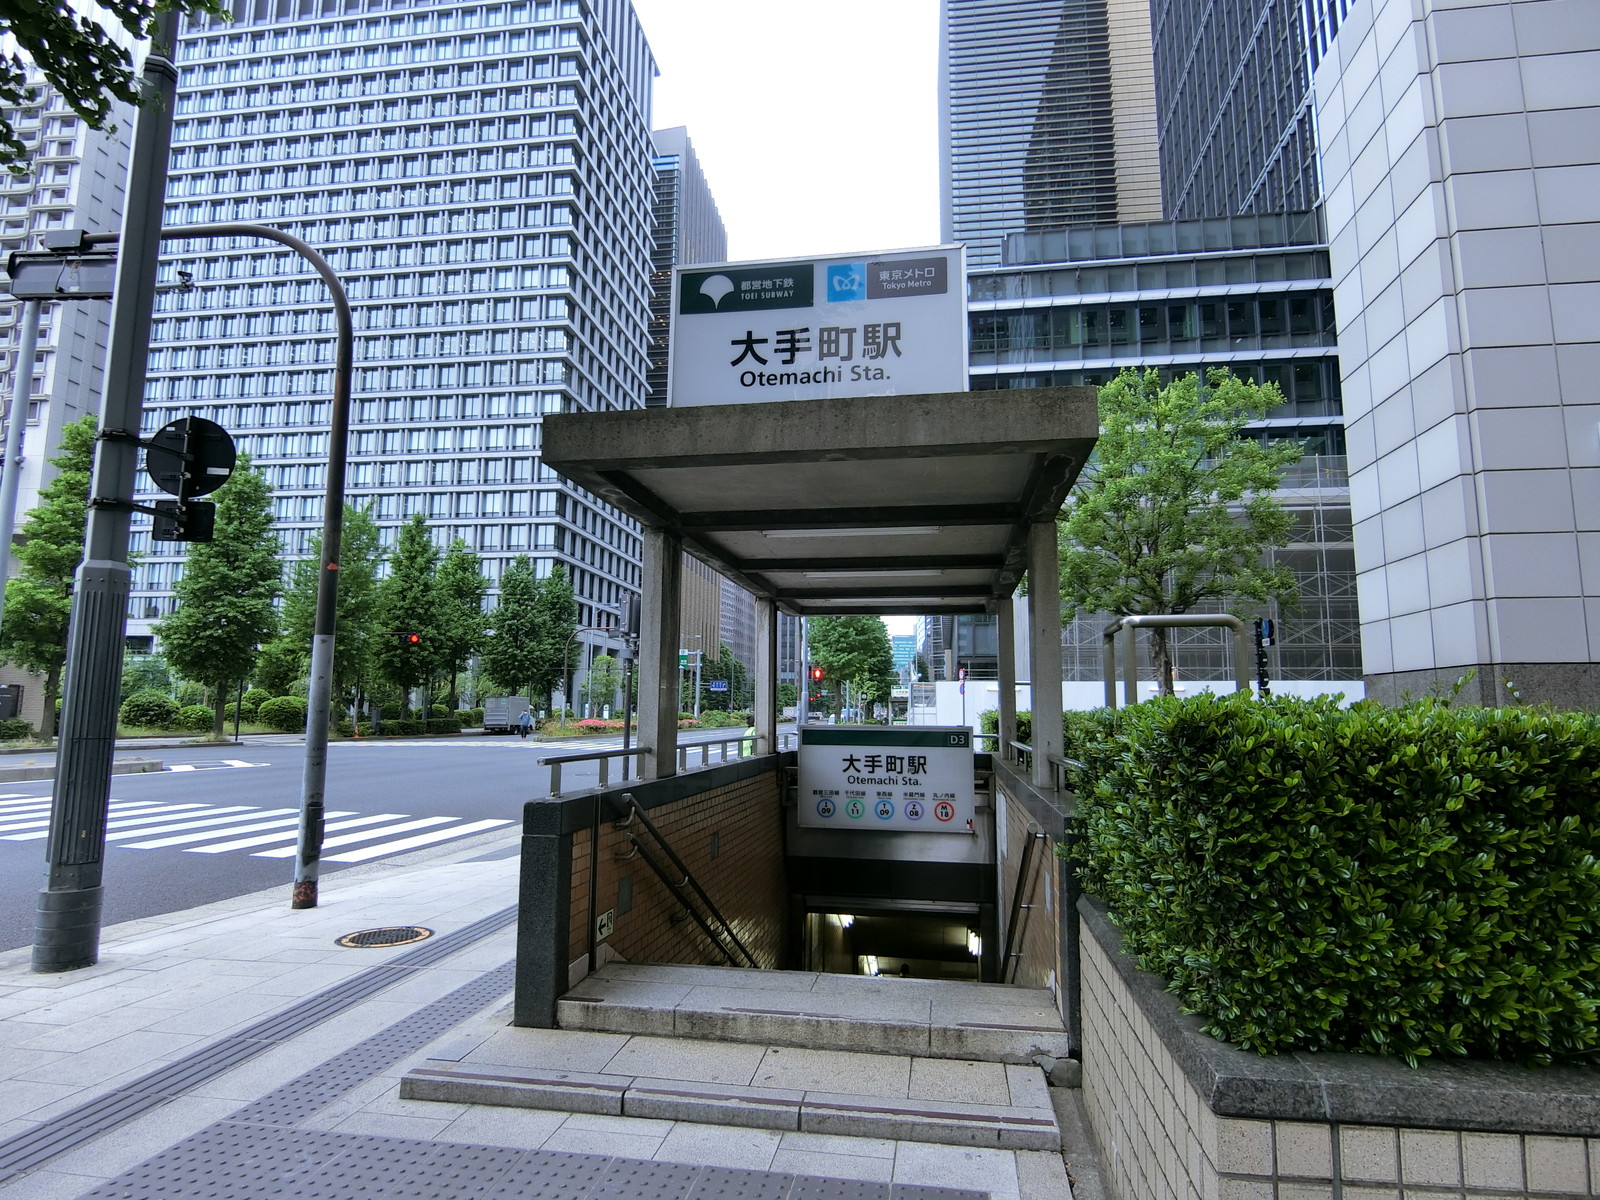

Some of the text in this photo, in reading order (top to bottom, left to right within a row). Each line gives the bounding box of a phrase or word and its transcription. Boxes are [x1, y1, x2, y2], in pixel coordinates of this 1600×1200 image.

[879, 268, 935, 282] 東京メトロ
[740, 278, 794, 291] 都営地下鉄
[882, 279, 932, 290] Tokyo Metro
[740, 290, 794, 300] TOEI SUBWAY
[730, 322, 902, 367] 大手町駅
[740, 365, 891, 387] Otemachi Sta.
[950, 734, 965, 745] D3
[842, 754, 927, 775] 大手町駅
[847, 775, 922, 786] Otemachi Sta.
